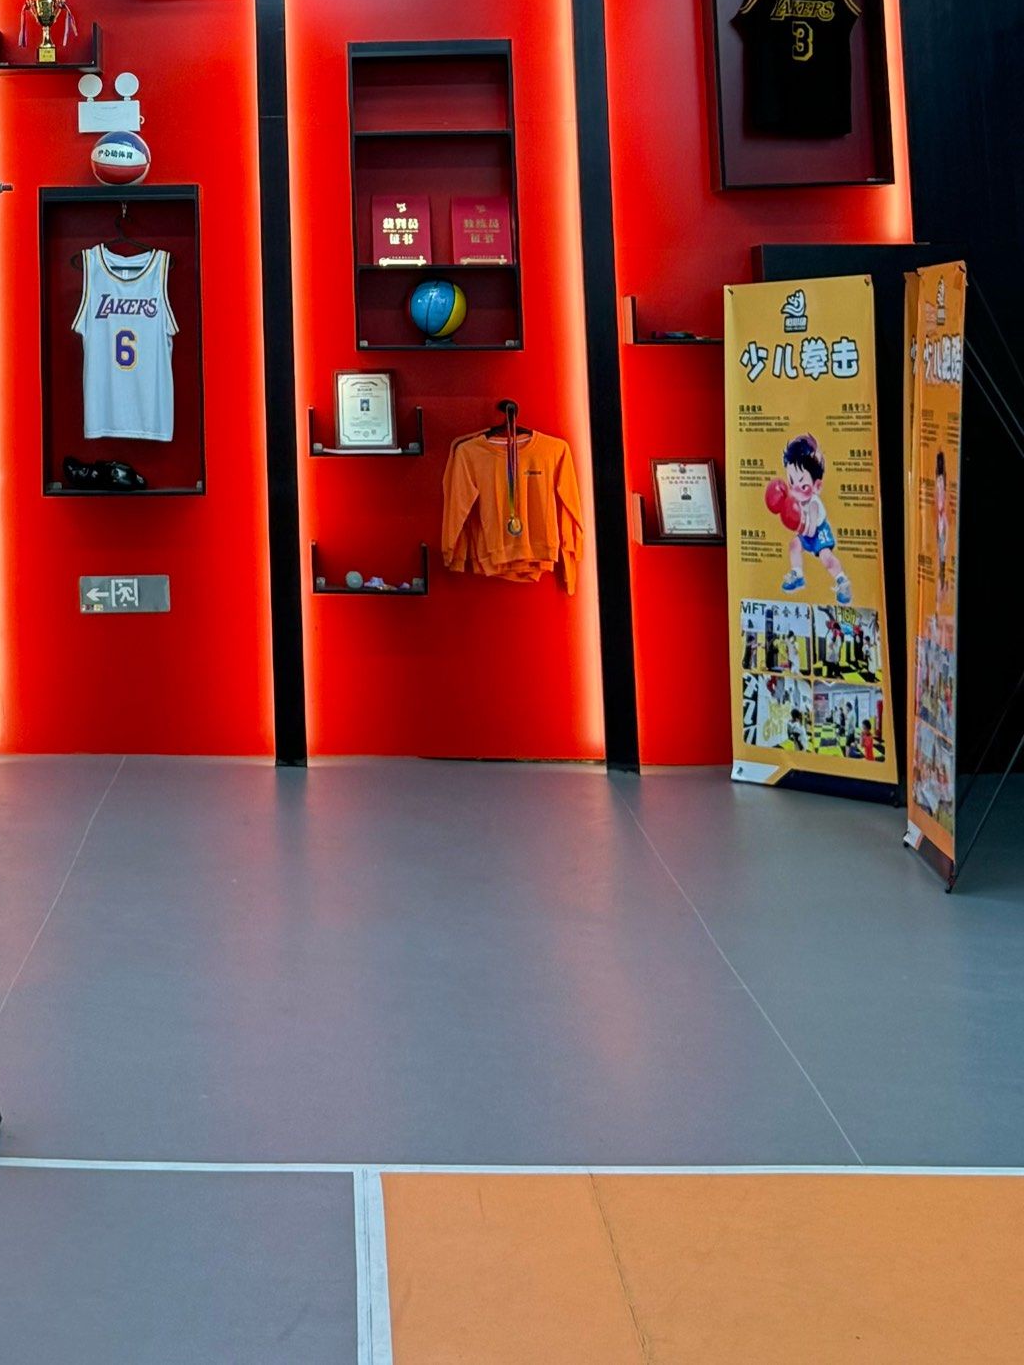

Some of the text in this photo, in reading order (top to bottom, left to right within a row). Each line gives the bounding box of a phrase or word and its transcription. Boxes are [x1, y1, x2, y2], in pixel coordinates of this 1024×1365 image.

[792, 21, 813, 61] 3
[95, 294, 158, 319] LAKERS
[114, 329, 137, 368] 6
[740, 337, 859, 382] 少儿拳击
